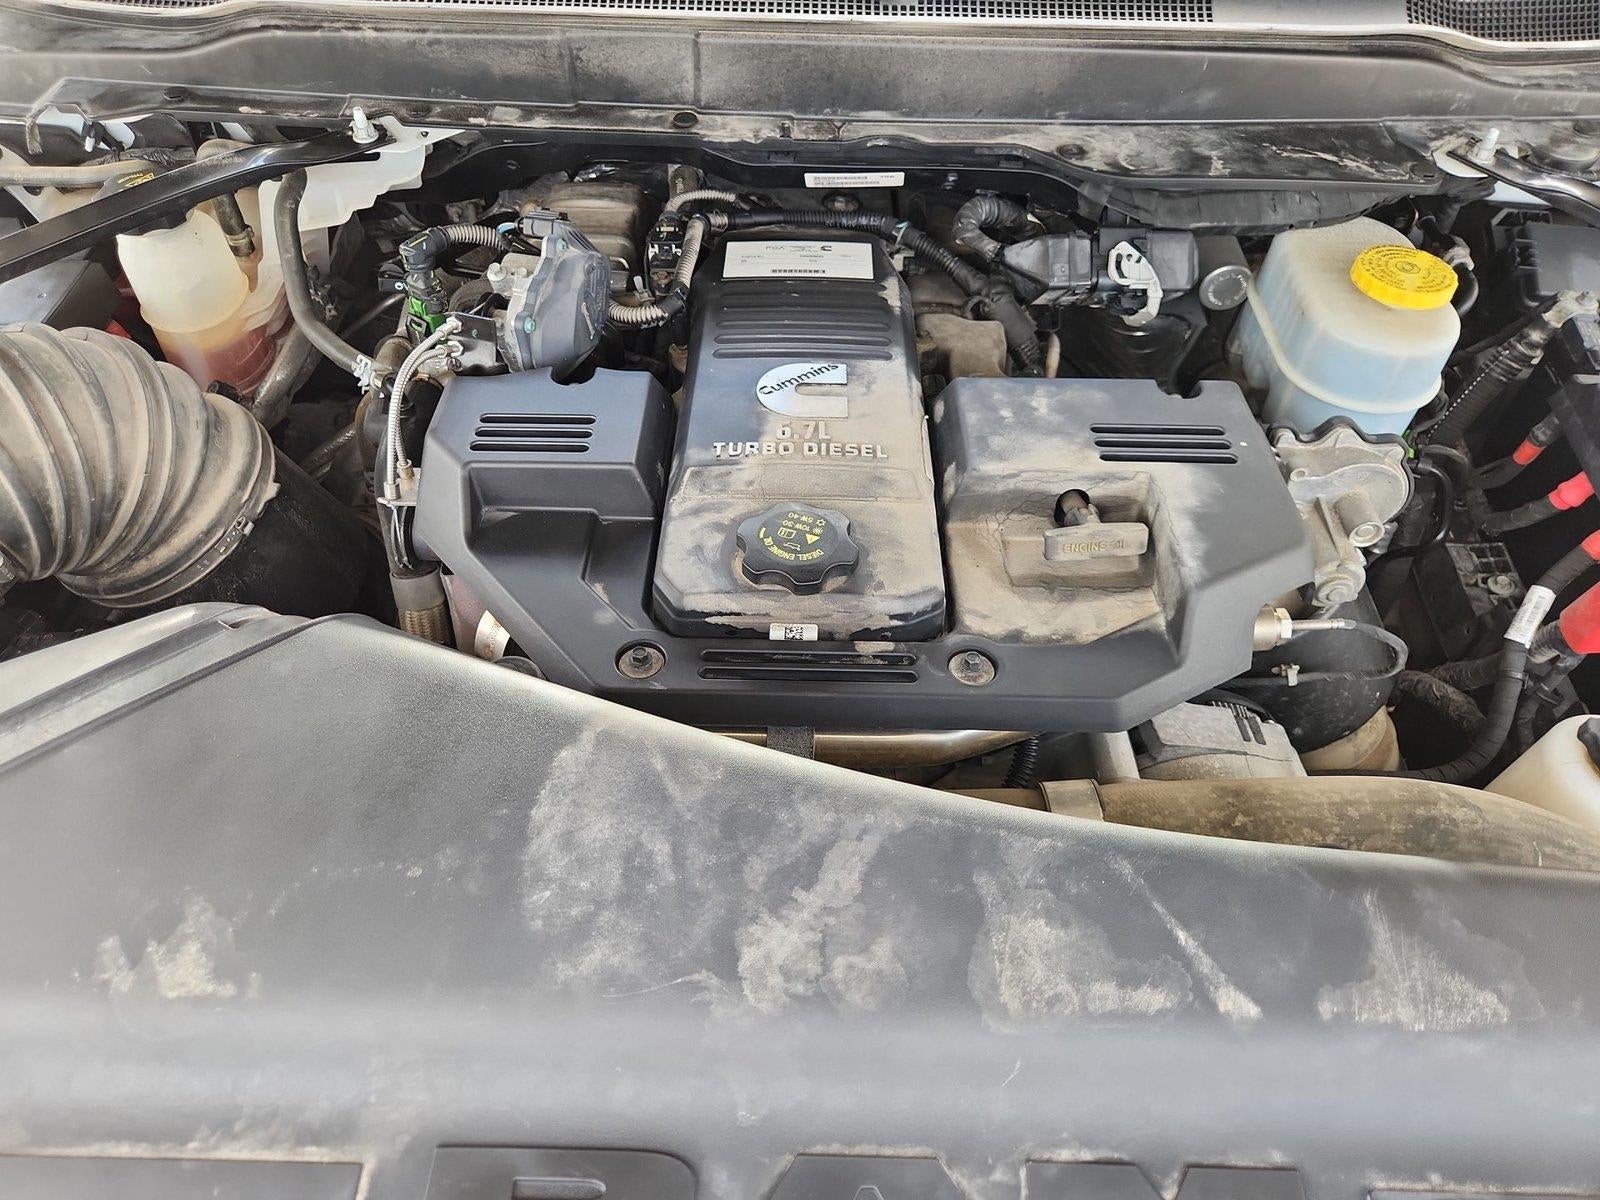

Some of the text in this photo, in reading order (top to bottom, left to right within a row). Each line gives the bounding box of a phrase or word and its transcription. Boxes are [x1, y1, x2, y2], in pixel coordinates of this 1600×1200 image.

[758, 363, 839, 395] Cummins
[776, 421, 831, 440] 6.7L
[713, 441, 888, 459] TURBO DIESEL
[782, 520, 811, 532] 10W-30
[788, 512, 814, 523] 5W-40
[767, 544, 796, 561] ENGINE
[796, 548, 825, 561] DIESEL
